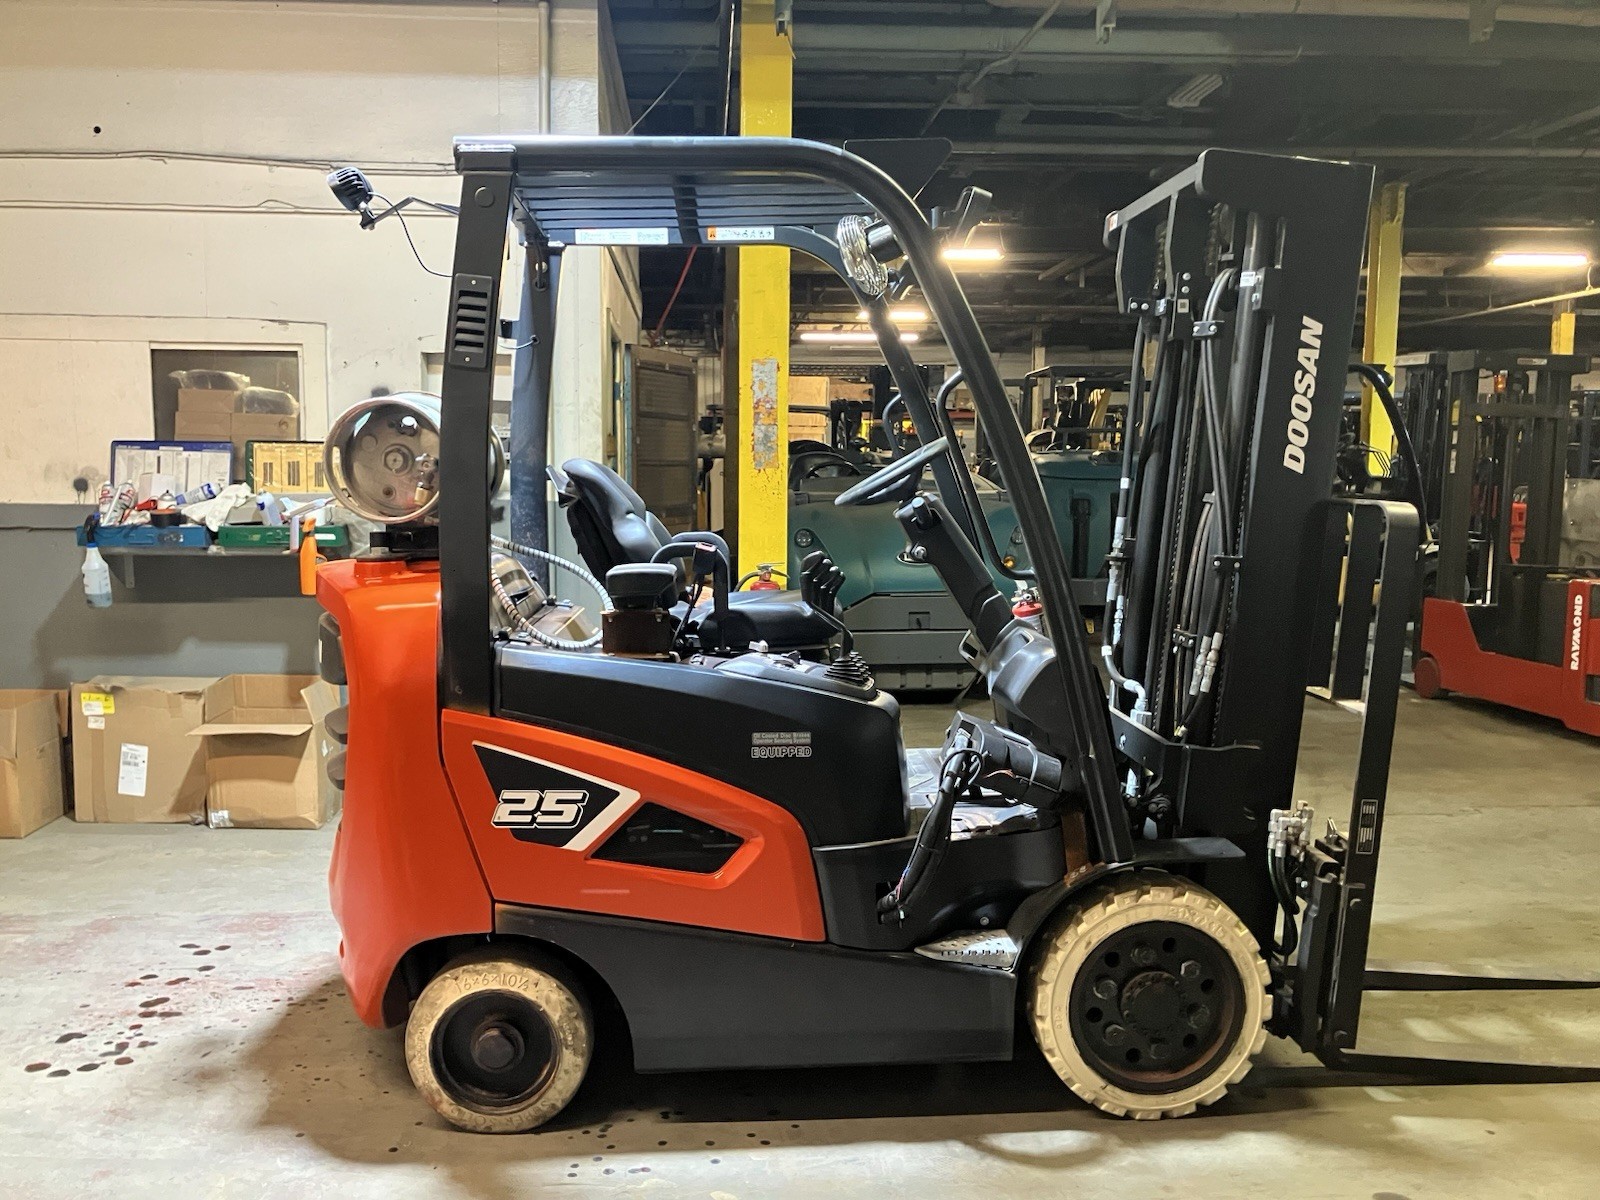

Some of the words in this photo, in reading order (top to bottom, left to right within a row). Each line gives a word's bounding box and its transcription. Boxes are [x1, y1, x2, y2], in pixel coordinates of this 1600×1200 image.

[1283, 315, 1323, 475] DOOSAN
[1570, 594, 1583, 671] RAYMOND
[751, 746, 812, 759] EQUIPPED
[491, 789, 589, 829] 25
